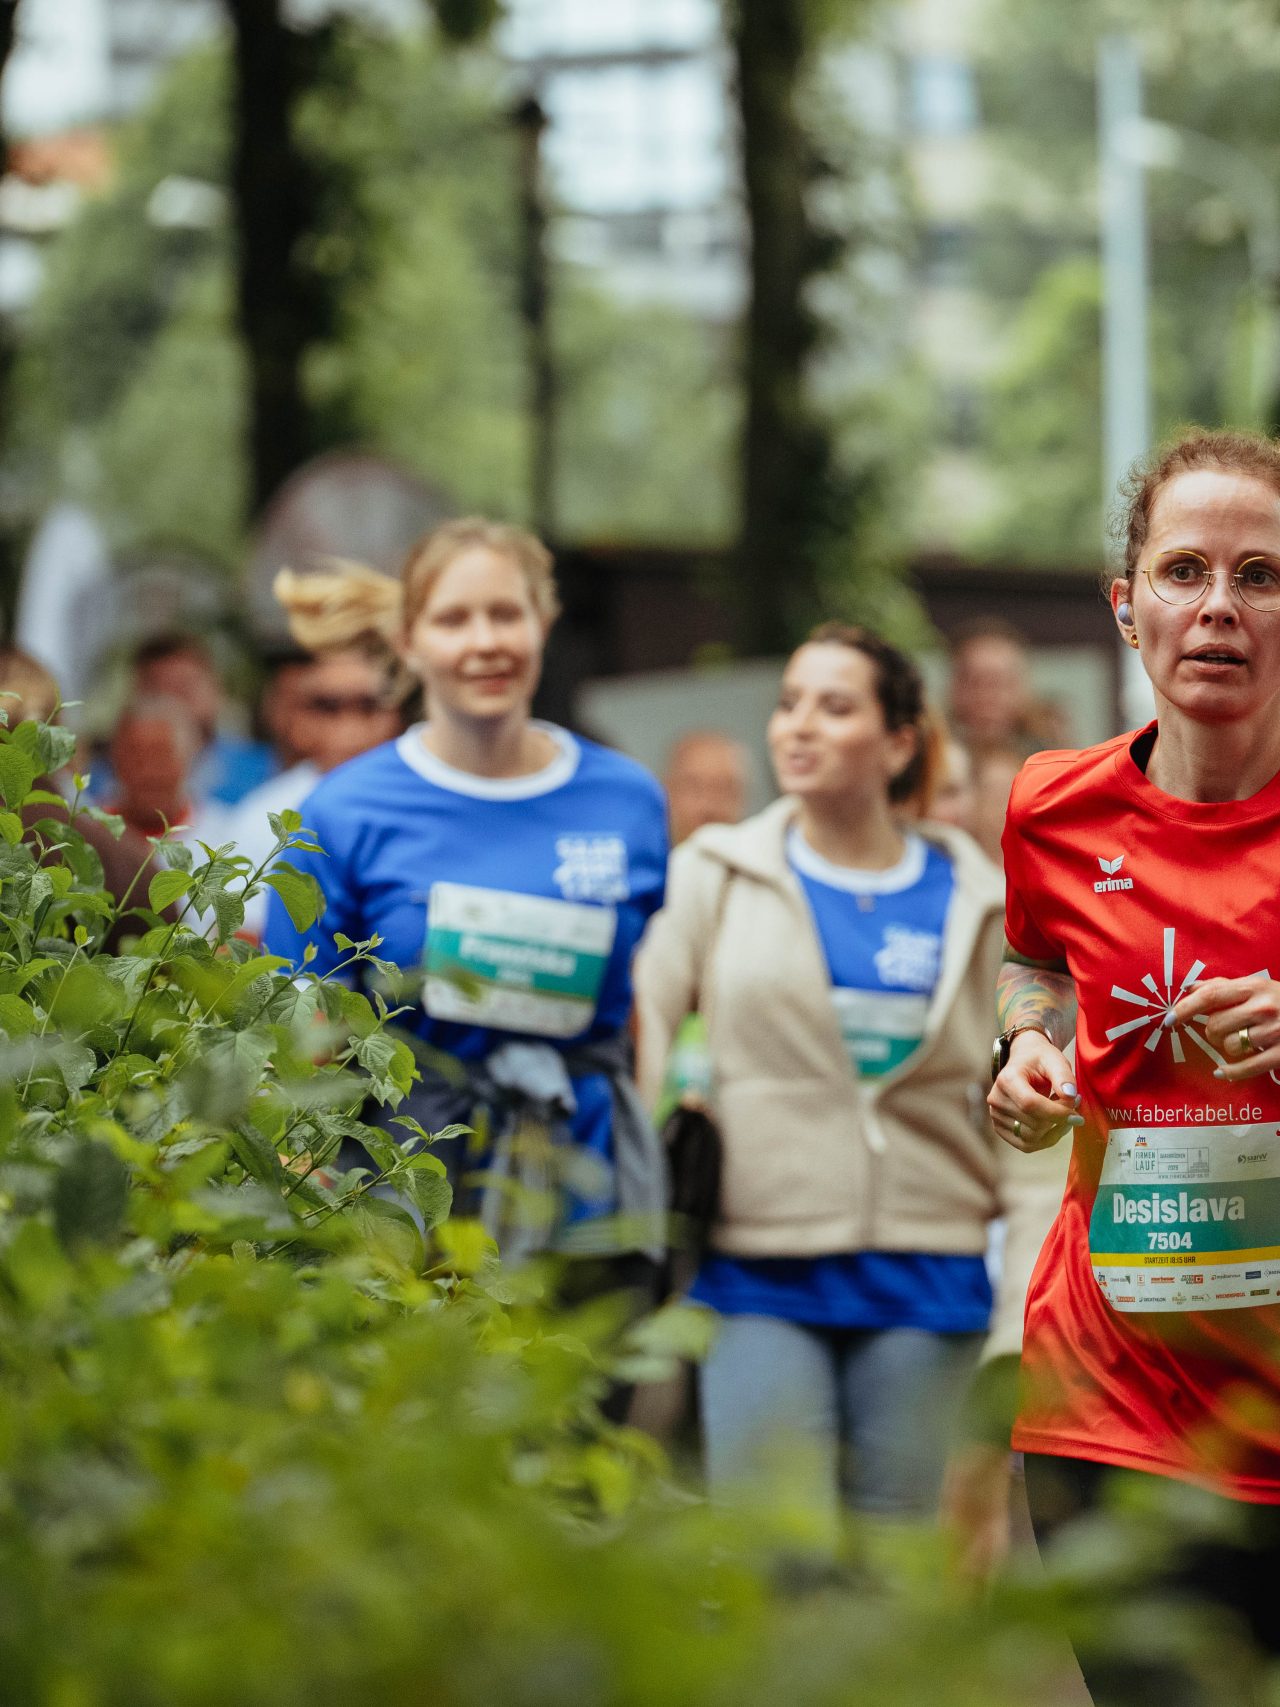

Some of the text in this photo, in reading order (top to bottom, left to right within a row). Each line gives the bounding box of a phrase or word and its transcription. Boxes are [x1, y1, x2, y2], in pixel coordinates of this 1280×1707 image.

[1094, 877, 1134, 893] erima
[1106, 1103, 1263, 1123] ww.faberkabel.de
[1135, 1151, 1156, 1159] FIRMEN
[1135, 1160, 1156, 1171] LAUF
[1113, 1192, 1246, 1224] Desislava
[1147, 1231, 1193, 1250] 7504
[1144, 1256, 1169, 1265] STARTZEIT
[1183, 1255, 1196, 1264] UHR
